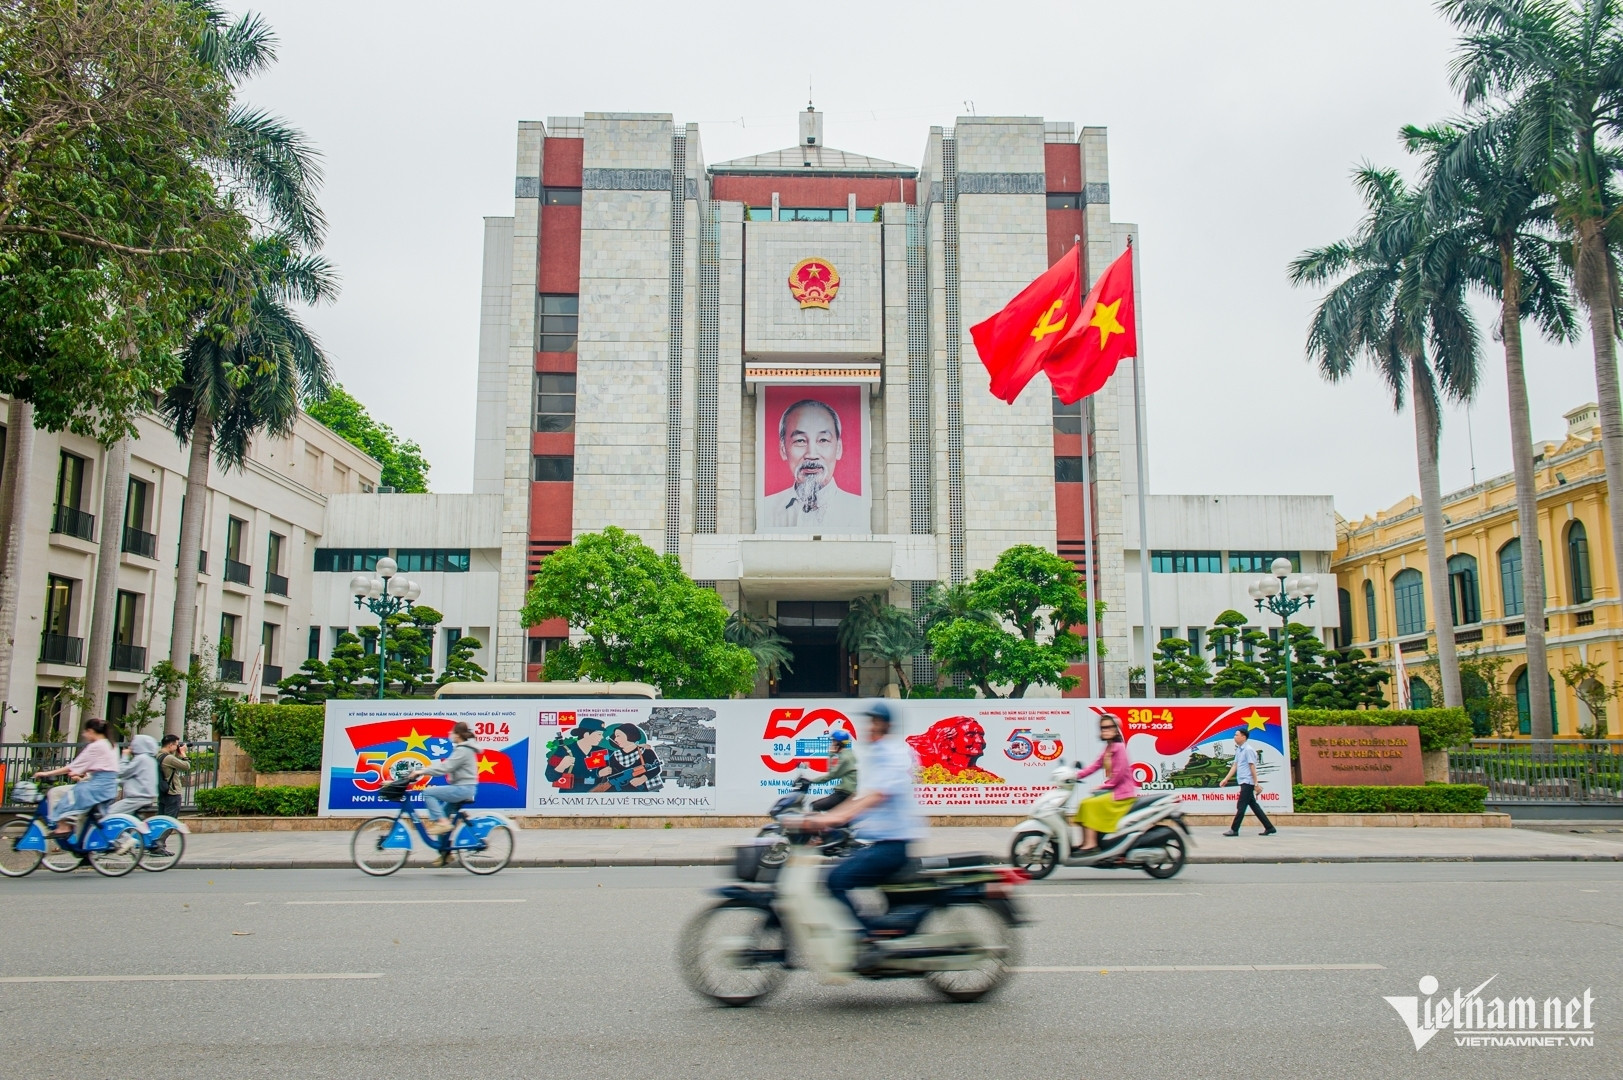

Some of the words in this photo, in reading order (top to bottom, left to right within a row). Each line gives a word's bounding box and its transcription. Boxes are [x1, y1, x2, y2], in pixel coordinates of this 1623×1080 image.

[1128, 709, 1173, 723] 30-4
[475, 722, 509, 734] 30.4
[1226, 792, 1240, 800] NHẤ
